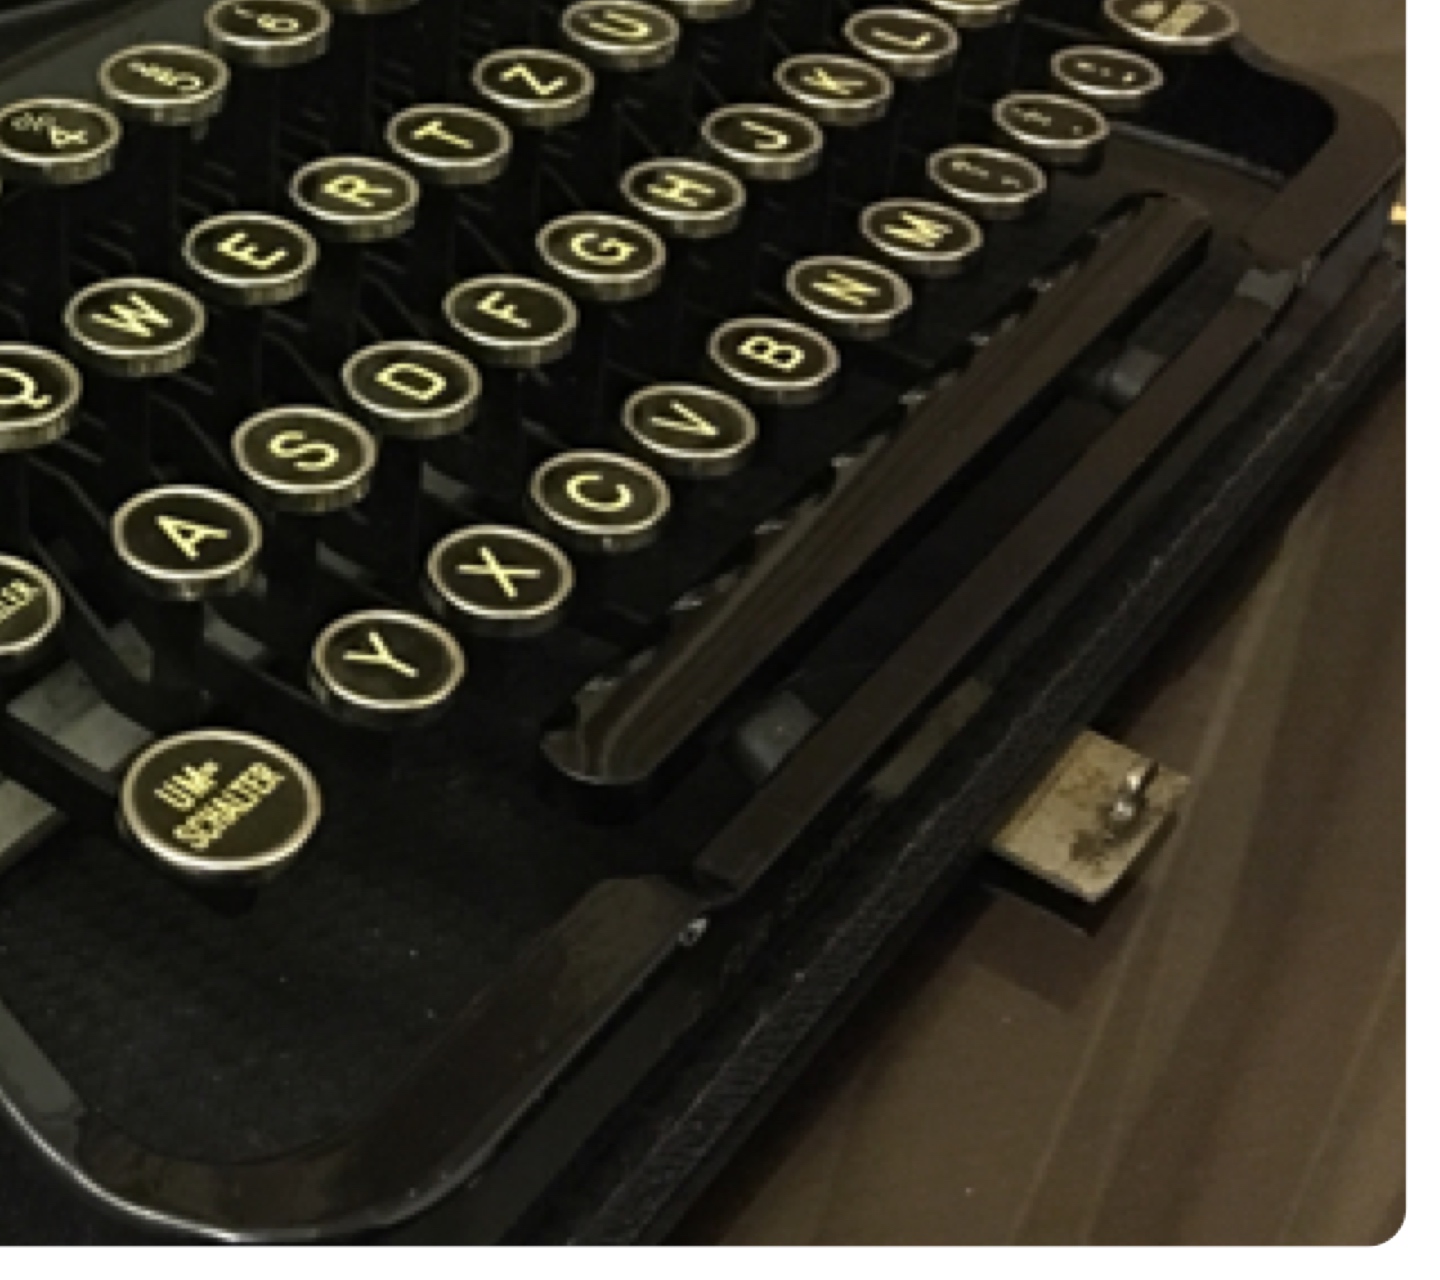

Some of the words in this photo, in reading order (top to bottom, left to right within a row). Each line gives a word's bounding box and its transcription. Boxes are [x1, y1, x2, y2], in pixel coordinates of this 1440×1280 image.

[870, 27, 931, 49] L
[498, 63, 568, 96] Z
[801, 66, 868, 96] K
[410, 119, 475, 150] T
[740, 119, 792, 150] J
[320, 174, 393, 208] R
[646, 173, 717, 208] H
[882, 210, 954, 247] M
[216, 230, 290, 271] E
[570, 232, 639, 265] G
[810, 269, 881, 307] N
[91, 291, 173, 338] W
[475, 289, 532, 328] F
[736, 334, 806, 373] B
[374, 361, 447, 402] D
[651, 401, 720, 437] V
[269, 429, 340, 472] S
[565, 473, 632, 513] C
[155, 513, 231, 560] A
[456, 545, 542, 598] X
[342, 632, 420, 677] Y
[171, 760, 286, 851] SCHALTER
